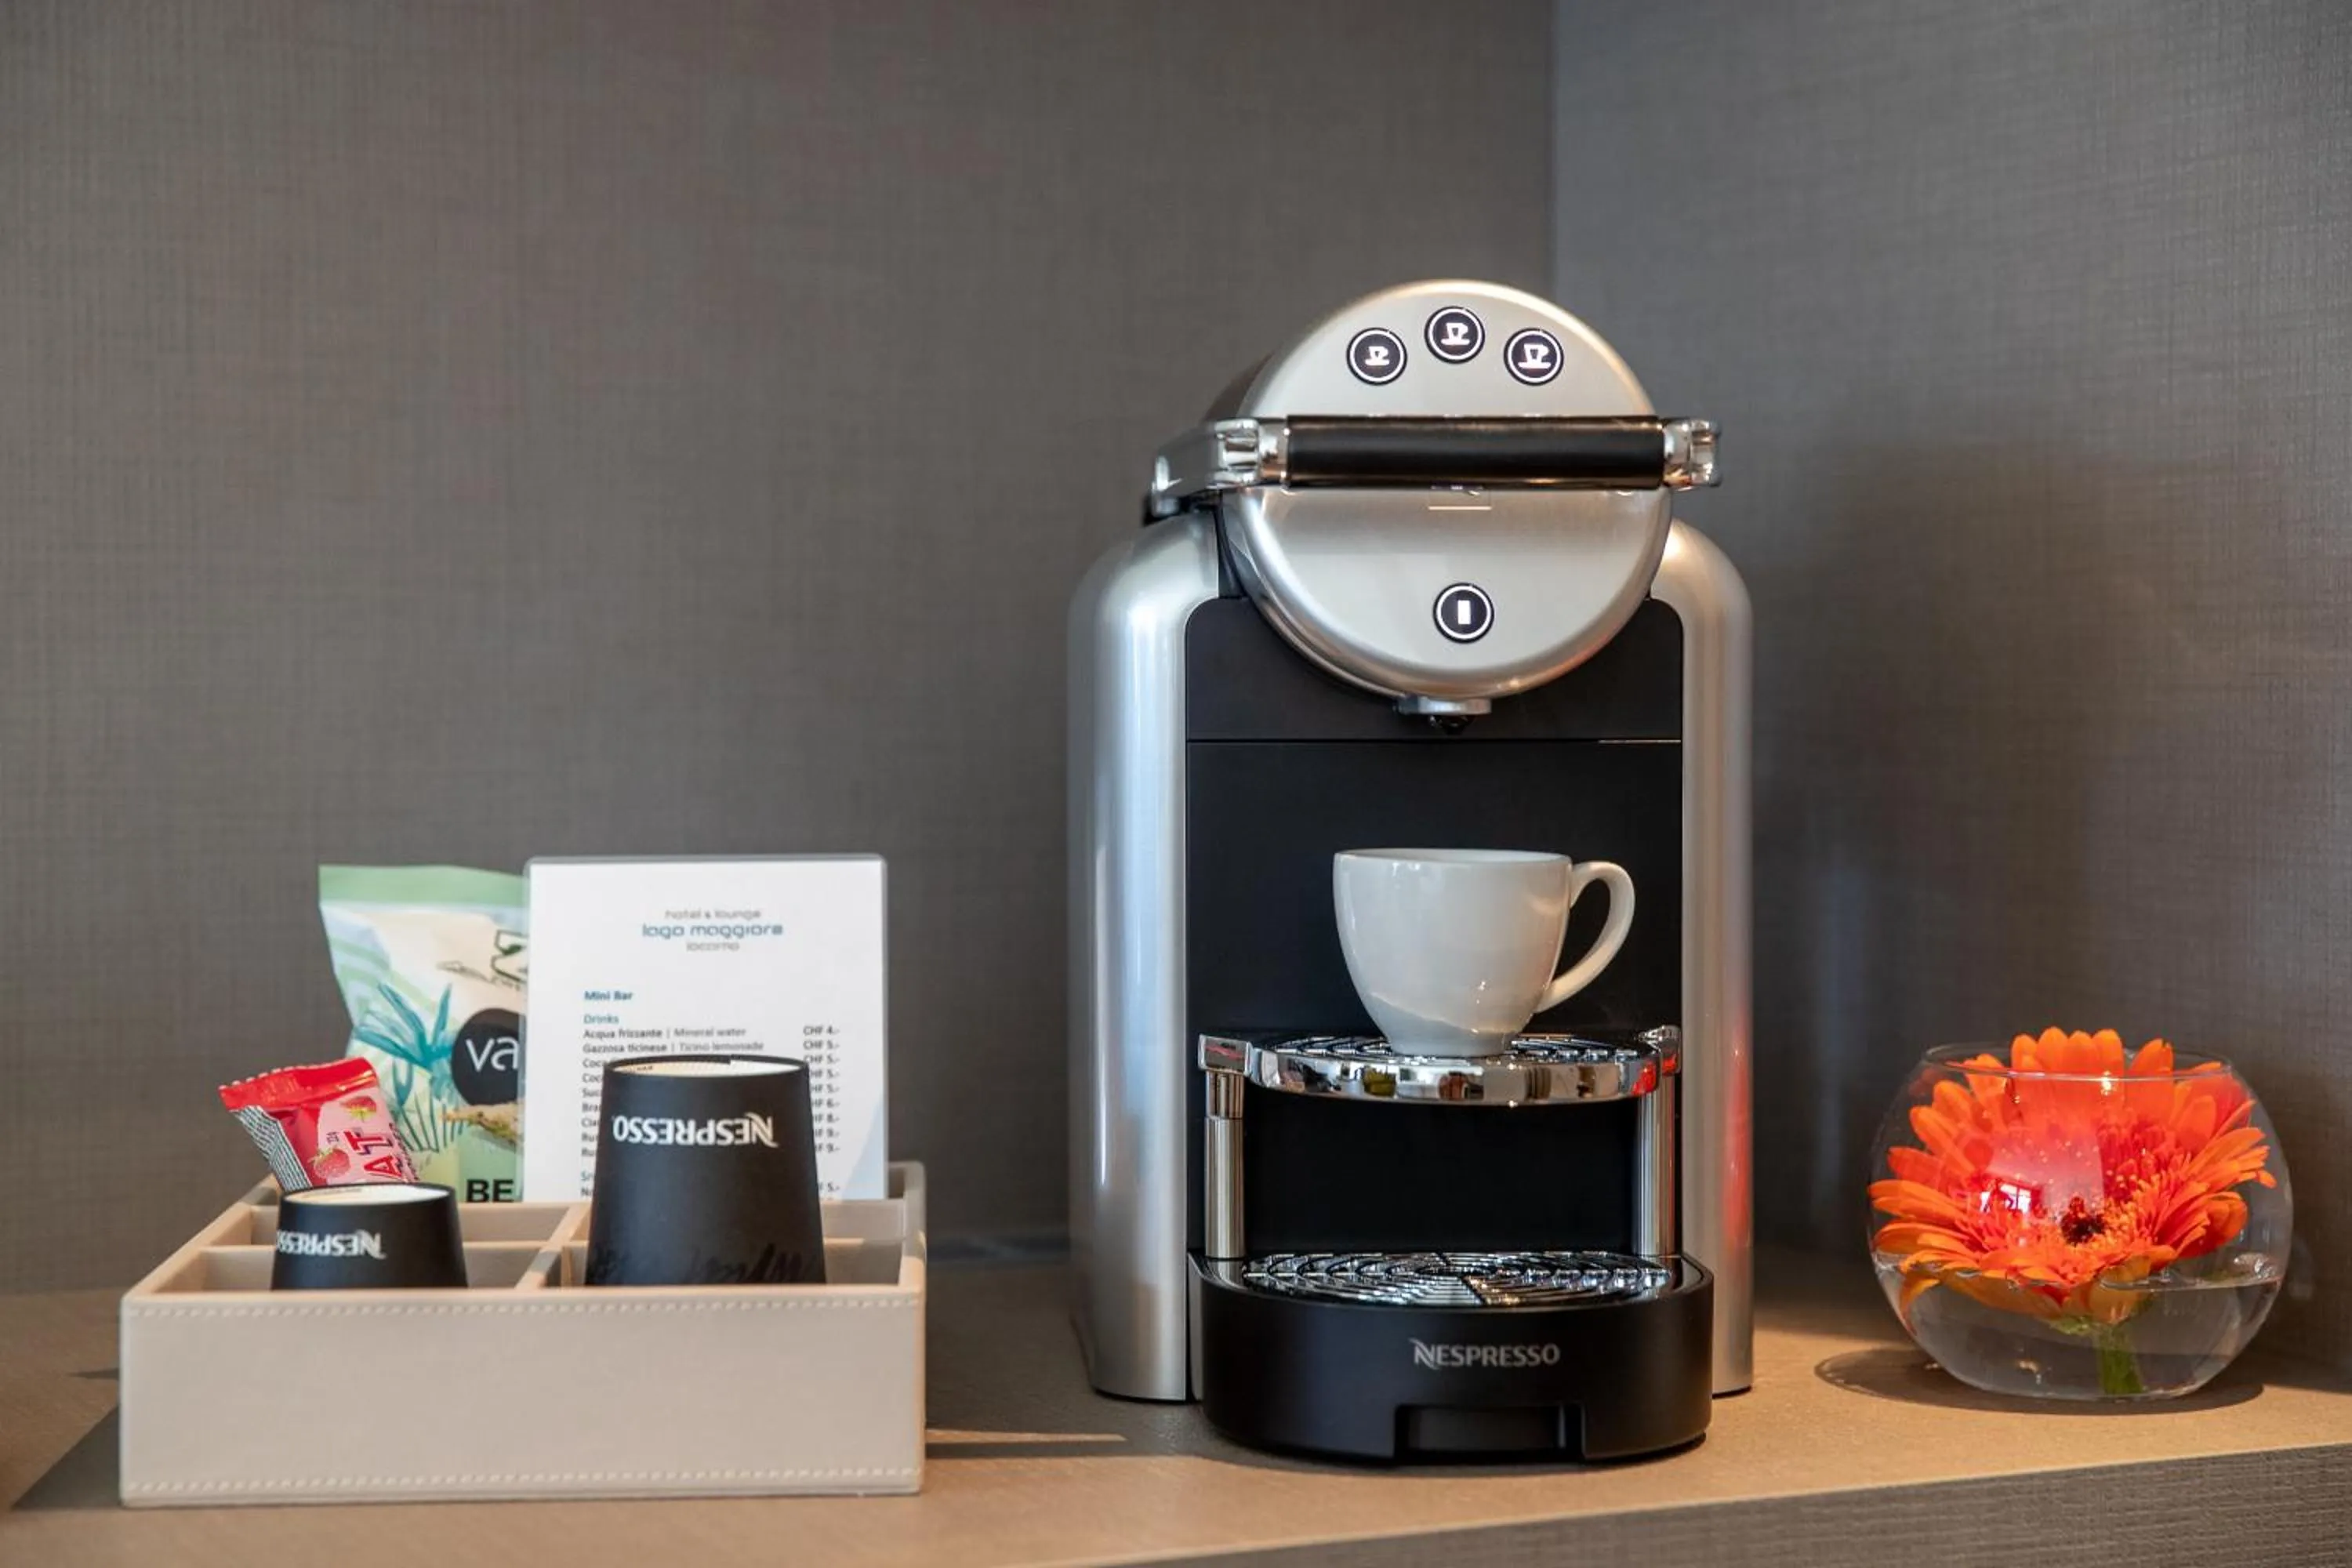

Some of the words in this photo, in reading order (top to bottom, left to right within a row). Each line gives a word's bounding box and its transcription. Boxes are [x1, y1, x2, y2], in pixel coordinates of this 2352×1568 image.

[714, 909, 761, 920] lounge
[584, 991, 610, 1000] Mini
[614, 991, 633, 1000] Bar
[583, 1014, 619, 1024] Drinks
[583, 1029, 615, 1039] Acqua
[717, 1029, 746, 1037] water
[803, 1025, 822, 1035] CHF
[803, 1040, 822, 1050] CHF
[466, 1036, 520, 1072] va
[612, 1112, 779, 1148] NESPRESSO
[466, 1179, 515, 1203] BE
[277, 1229, 387, 1260] NESPRESS
[1410, 1338, 1561, 1370] NESPRESSO
